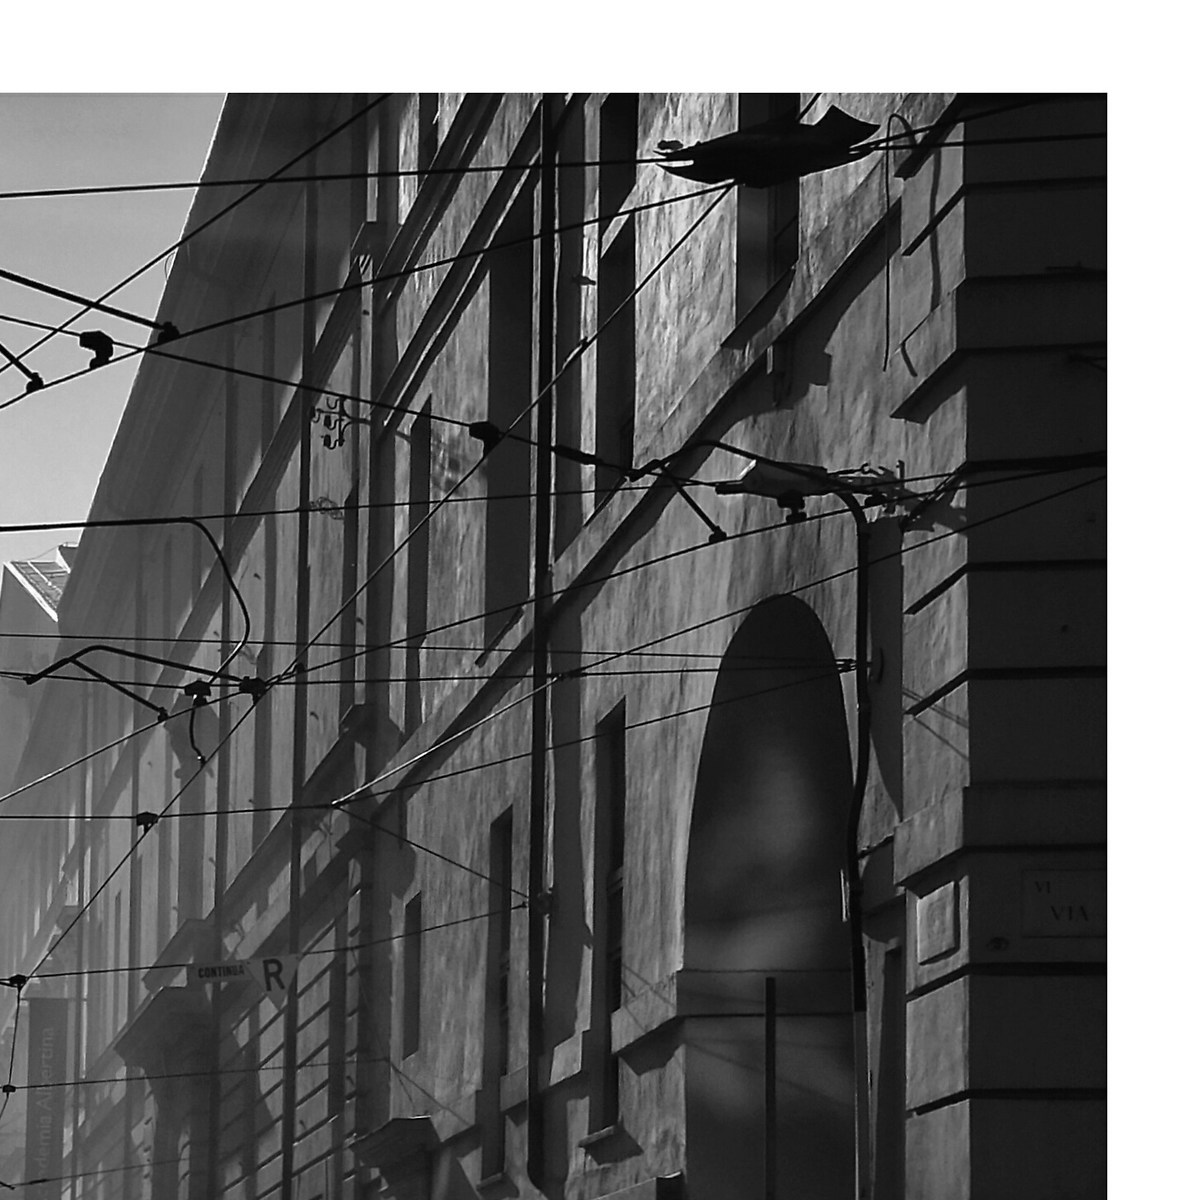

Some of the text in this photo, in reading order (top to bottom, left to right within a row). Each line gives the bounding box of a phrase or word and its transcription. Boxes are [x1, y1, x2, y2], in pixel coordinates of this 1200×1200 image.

[1050, 905, 1089, 921] VIA
[197, 964, 246, 979] CONTINUA
[262, 958, 286, 992] R
[34, 1026, 55, 1111] Albertina
